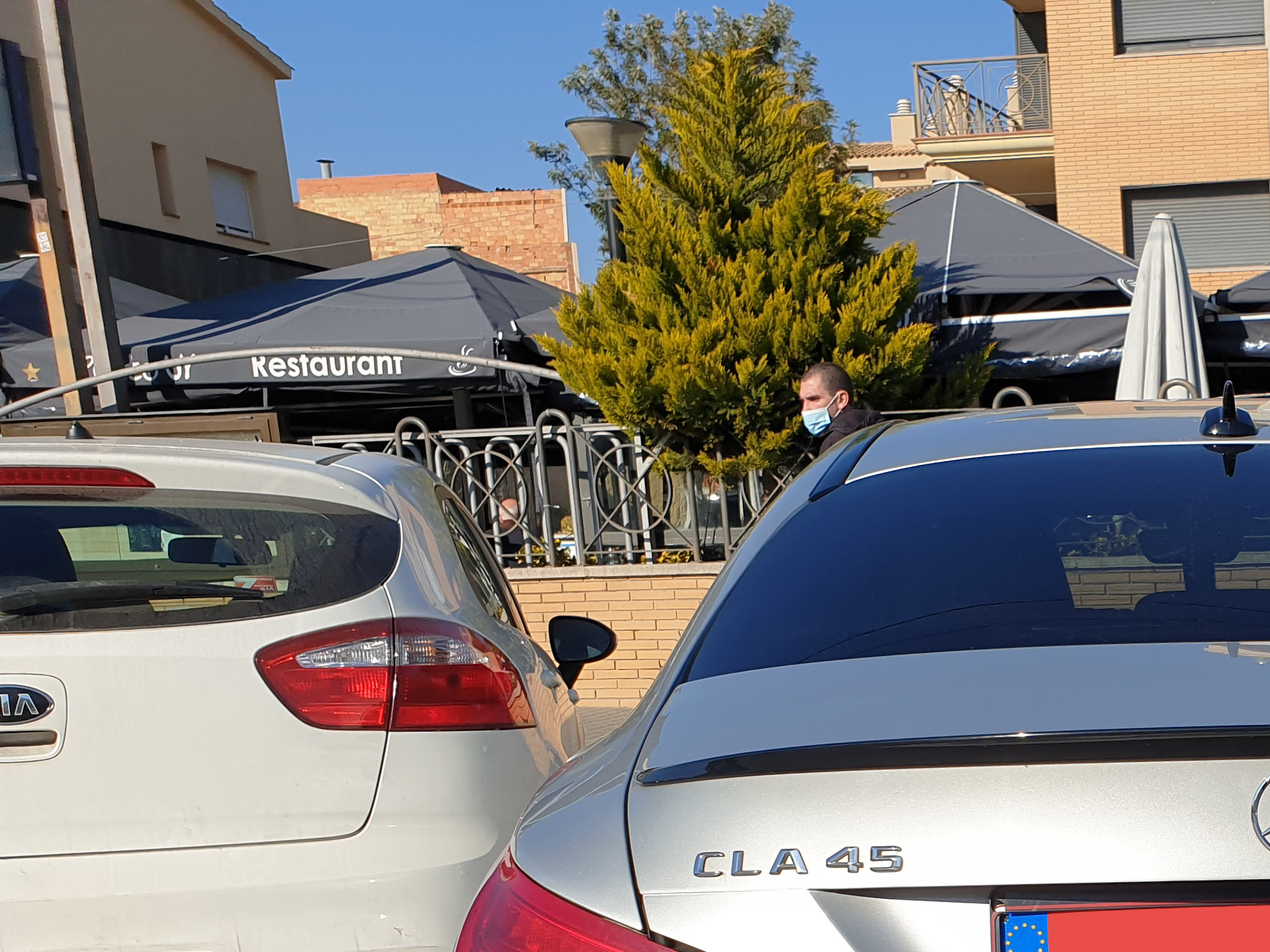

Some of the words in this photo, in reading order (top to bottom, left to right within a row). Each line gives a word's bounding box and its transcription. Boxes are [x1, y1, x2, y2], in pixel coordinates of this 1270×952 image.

[251, 353, 404, 378] Restaurant
[693, 848, 809, 878] CLA
[825, 845, 904, 874] 45
